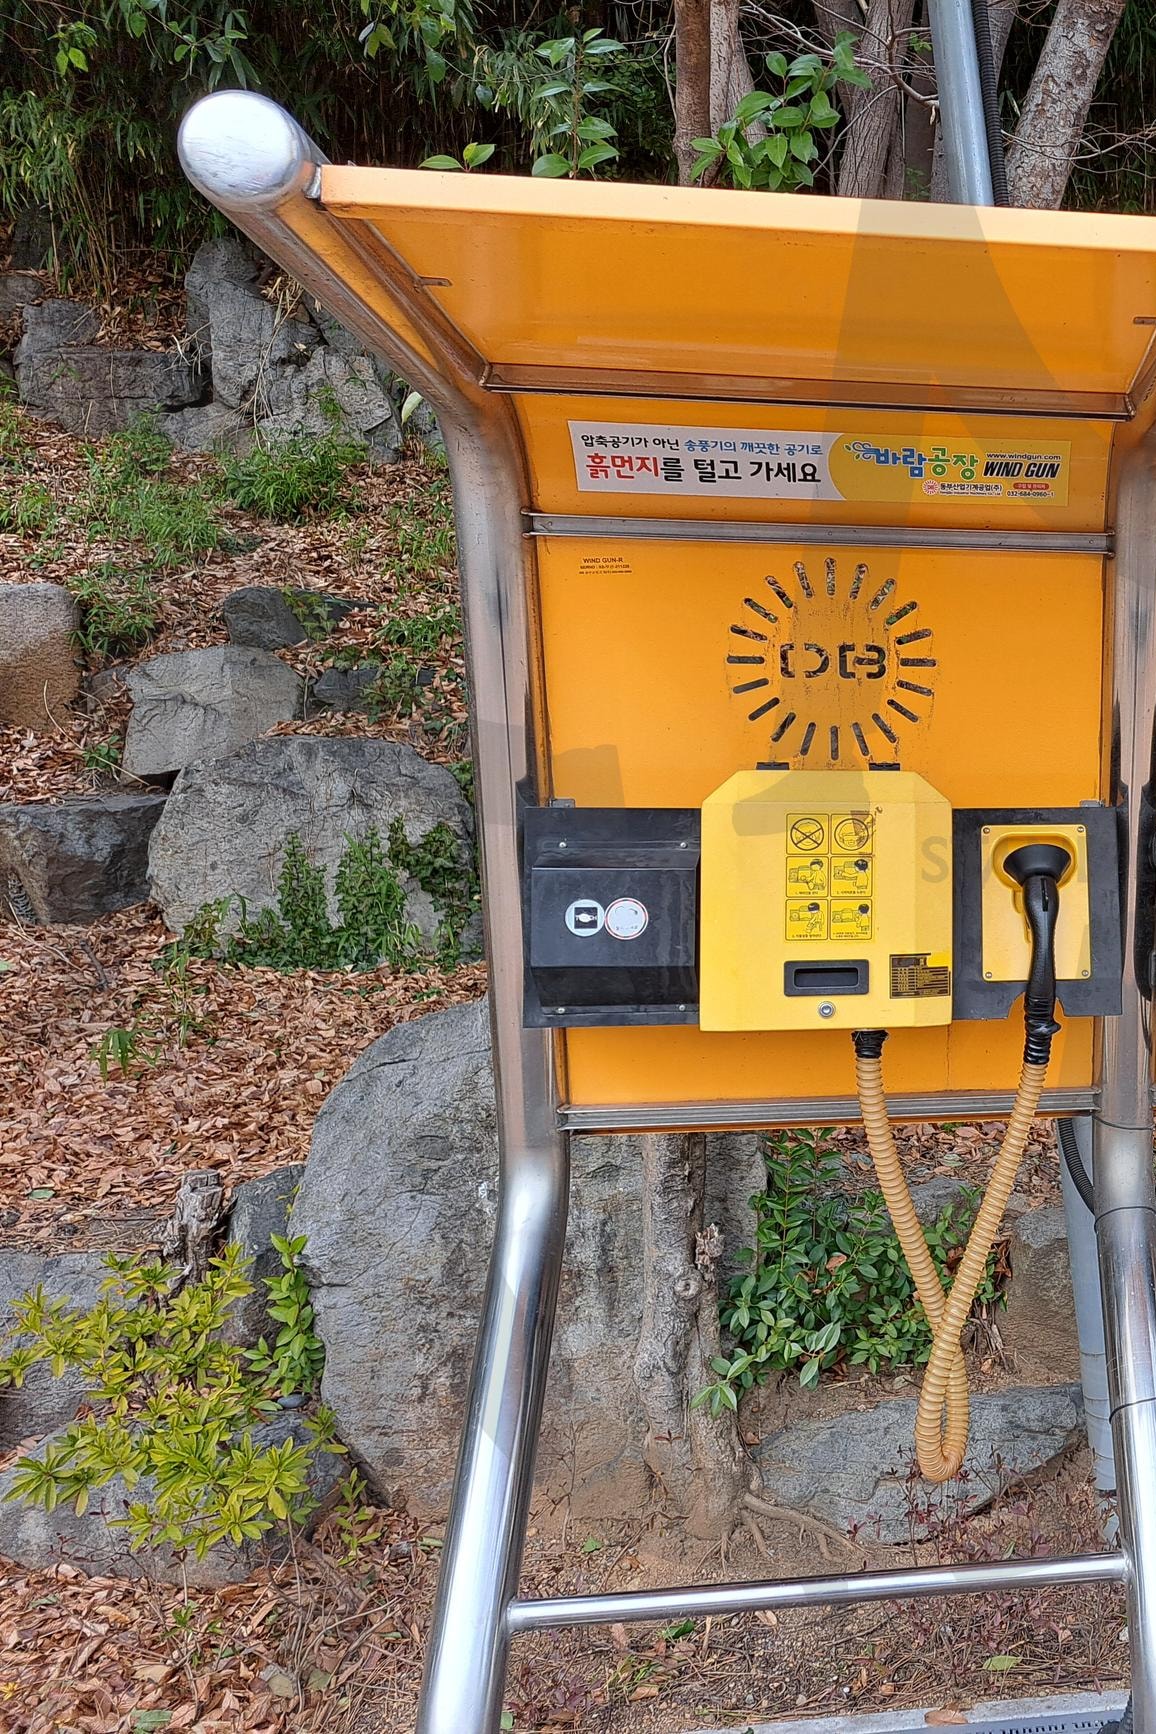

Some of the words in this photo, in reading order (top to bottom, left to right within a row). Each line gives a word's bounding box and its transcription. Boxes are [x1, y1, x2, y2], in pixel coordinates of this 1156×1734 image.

[581, 434, 648, 449] 압축공기가
[653, 437, 680, 450] 아닌
[684, 439, 736, 453] 송풍기의
[740, 441, 780, 455] 깨끗한
[784, 443, 823, 455] 공기로
[586, 452, 685, 482] 흙먼지를
[693, 457, 742, 483] 털고
[750, 461, 822, 483] 가세요
[870, 446, 979, 480] 바람공장
[986, 452, 1062, 462] www.windgun.com
[983, 461, 1023, 478] WIND
[1025, 462, 1061, 479] GUN
